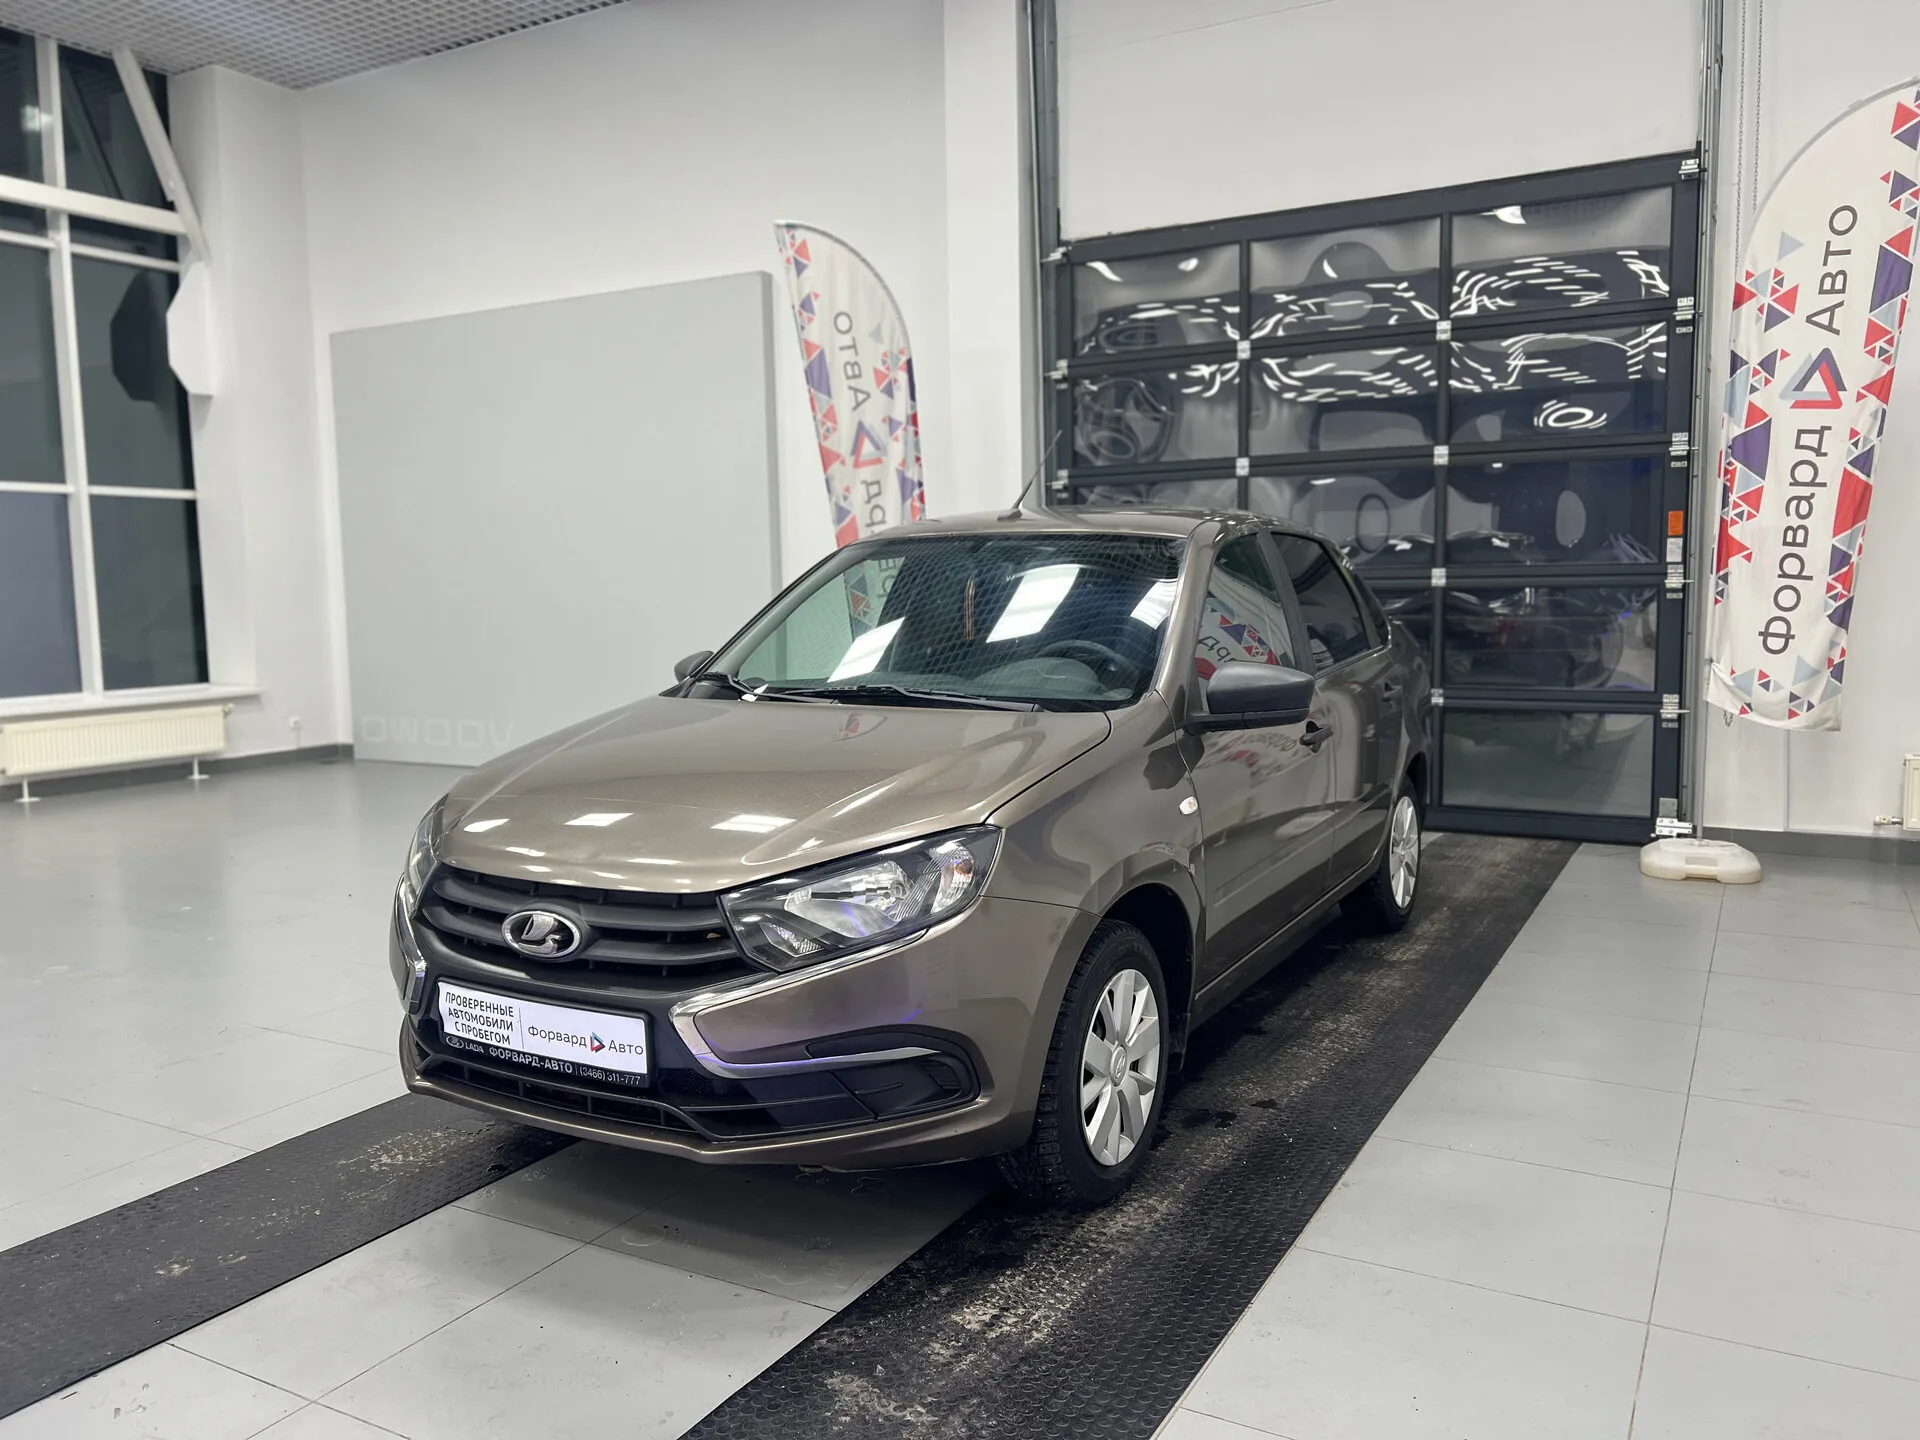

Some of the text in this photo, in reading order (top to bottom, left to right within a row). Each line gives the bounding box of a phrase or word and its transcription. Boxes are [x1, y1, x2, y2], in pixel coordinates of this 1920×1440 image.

[1758, 204, 1858, 656] Форвард Авто
[445, 991, 515, 1018] ПРОВЕРЕННЫЕ
[448, 1007, 514, 1032] АВТОМОБИЛИ
[454, 1021, 511, 1046] С ПРОБЕГОМ
[527, 1025, 645, 1056] Форвард Авто
[465, 1042, 484, 1054] LADA
[489, 1046, 573, 1074] ФОРВАРД-АВТО
